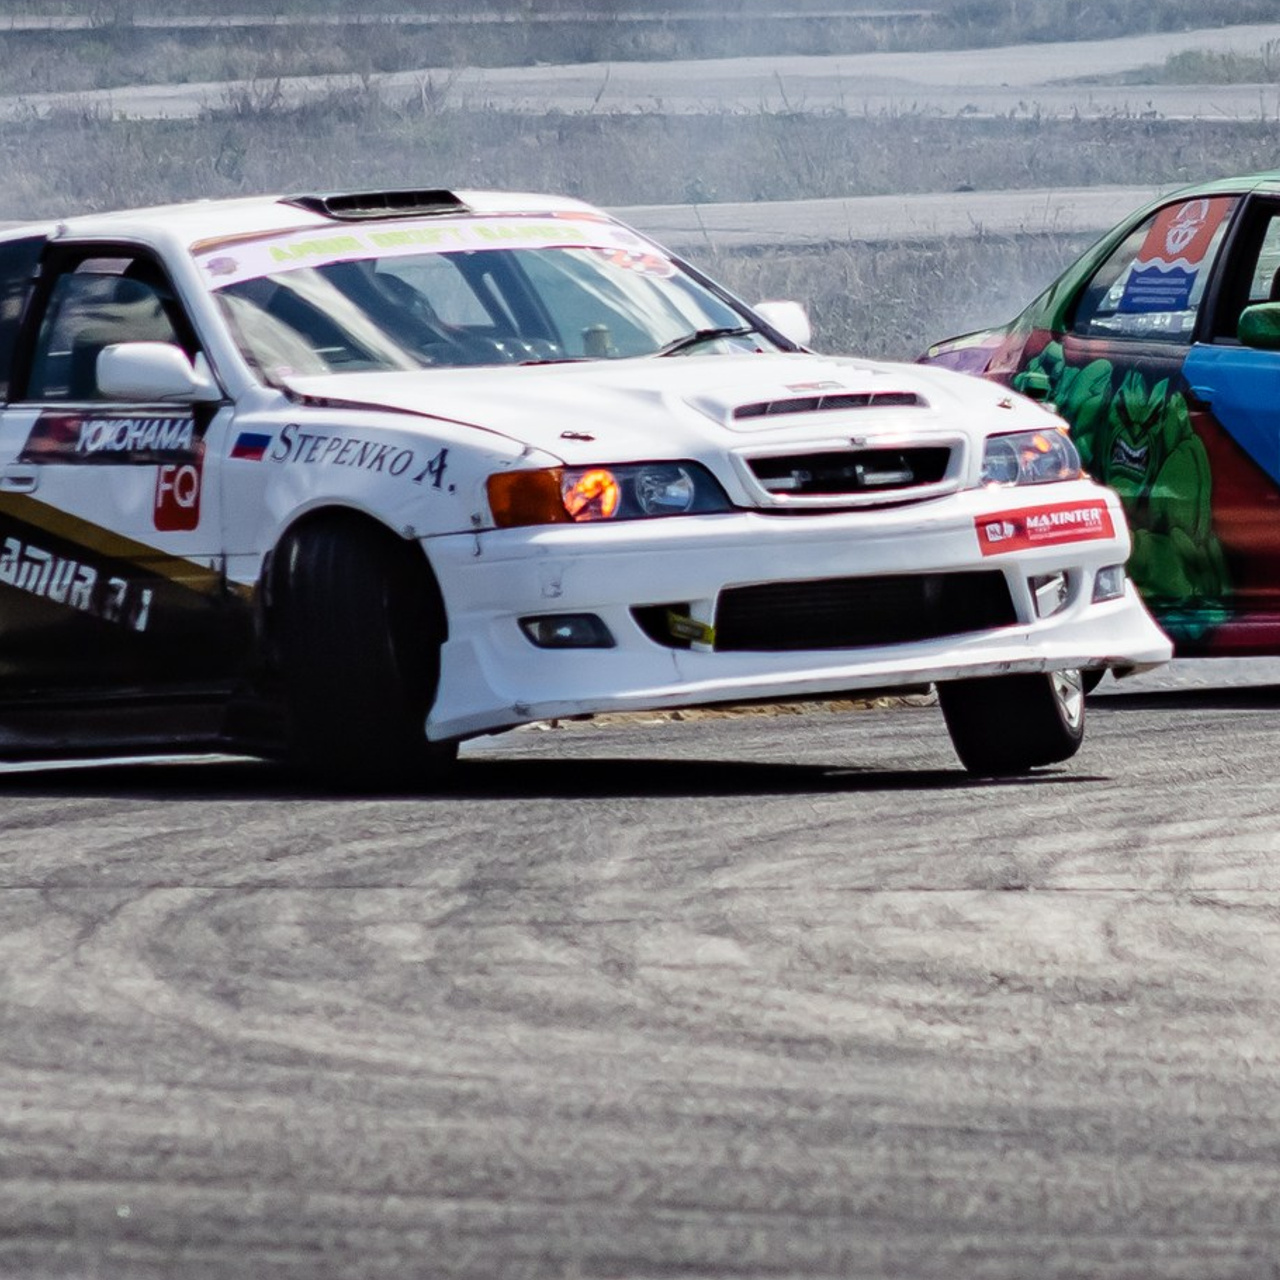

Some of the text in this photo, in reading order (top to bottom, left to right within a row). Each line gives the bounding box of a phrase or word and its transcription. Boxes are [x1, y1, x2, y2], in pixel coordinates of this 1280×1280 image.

[74, 420, 194, 452] YOKOHAMA
[156, 464, 199, 508] FQ
[412, 446, 457, 494] A.
[1026, 507, 1102, 528] MAXINTER
